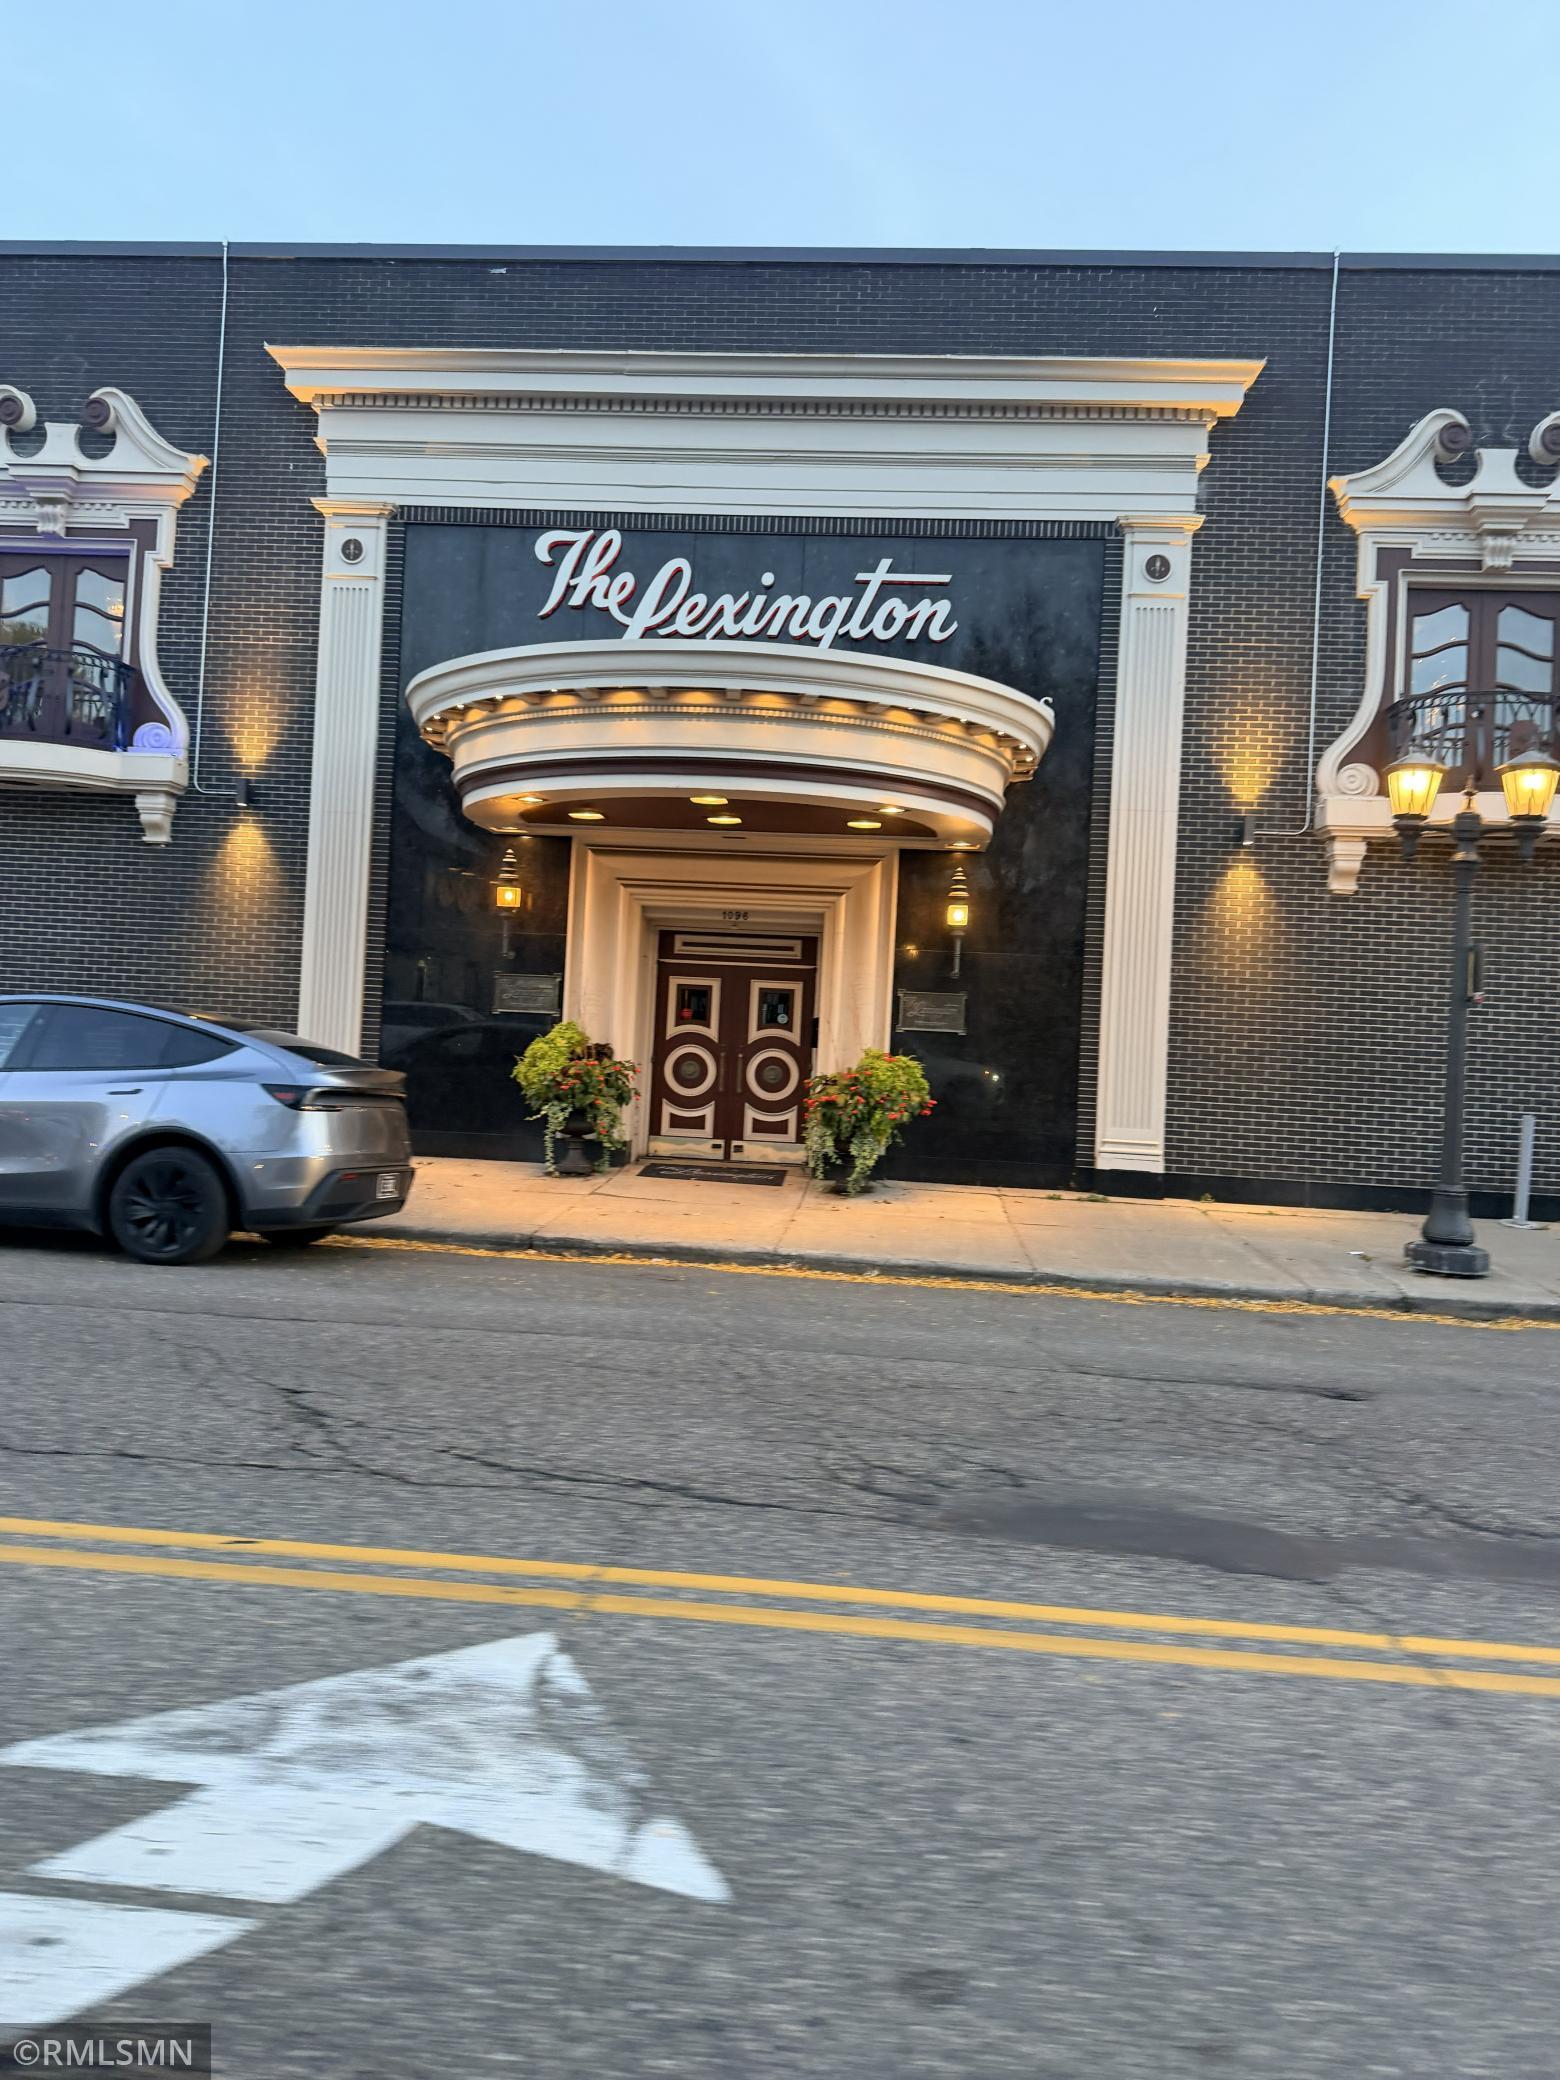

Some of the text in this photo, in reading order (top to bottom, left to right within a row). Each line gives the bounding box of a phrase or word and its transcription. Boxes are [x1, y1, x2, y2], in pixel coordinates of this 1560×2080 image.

[534, 529, 958, 649] The Lexington
[722, 911, 750, 921] 1096
